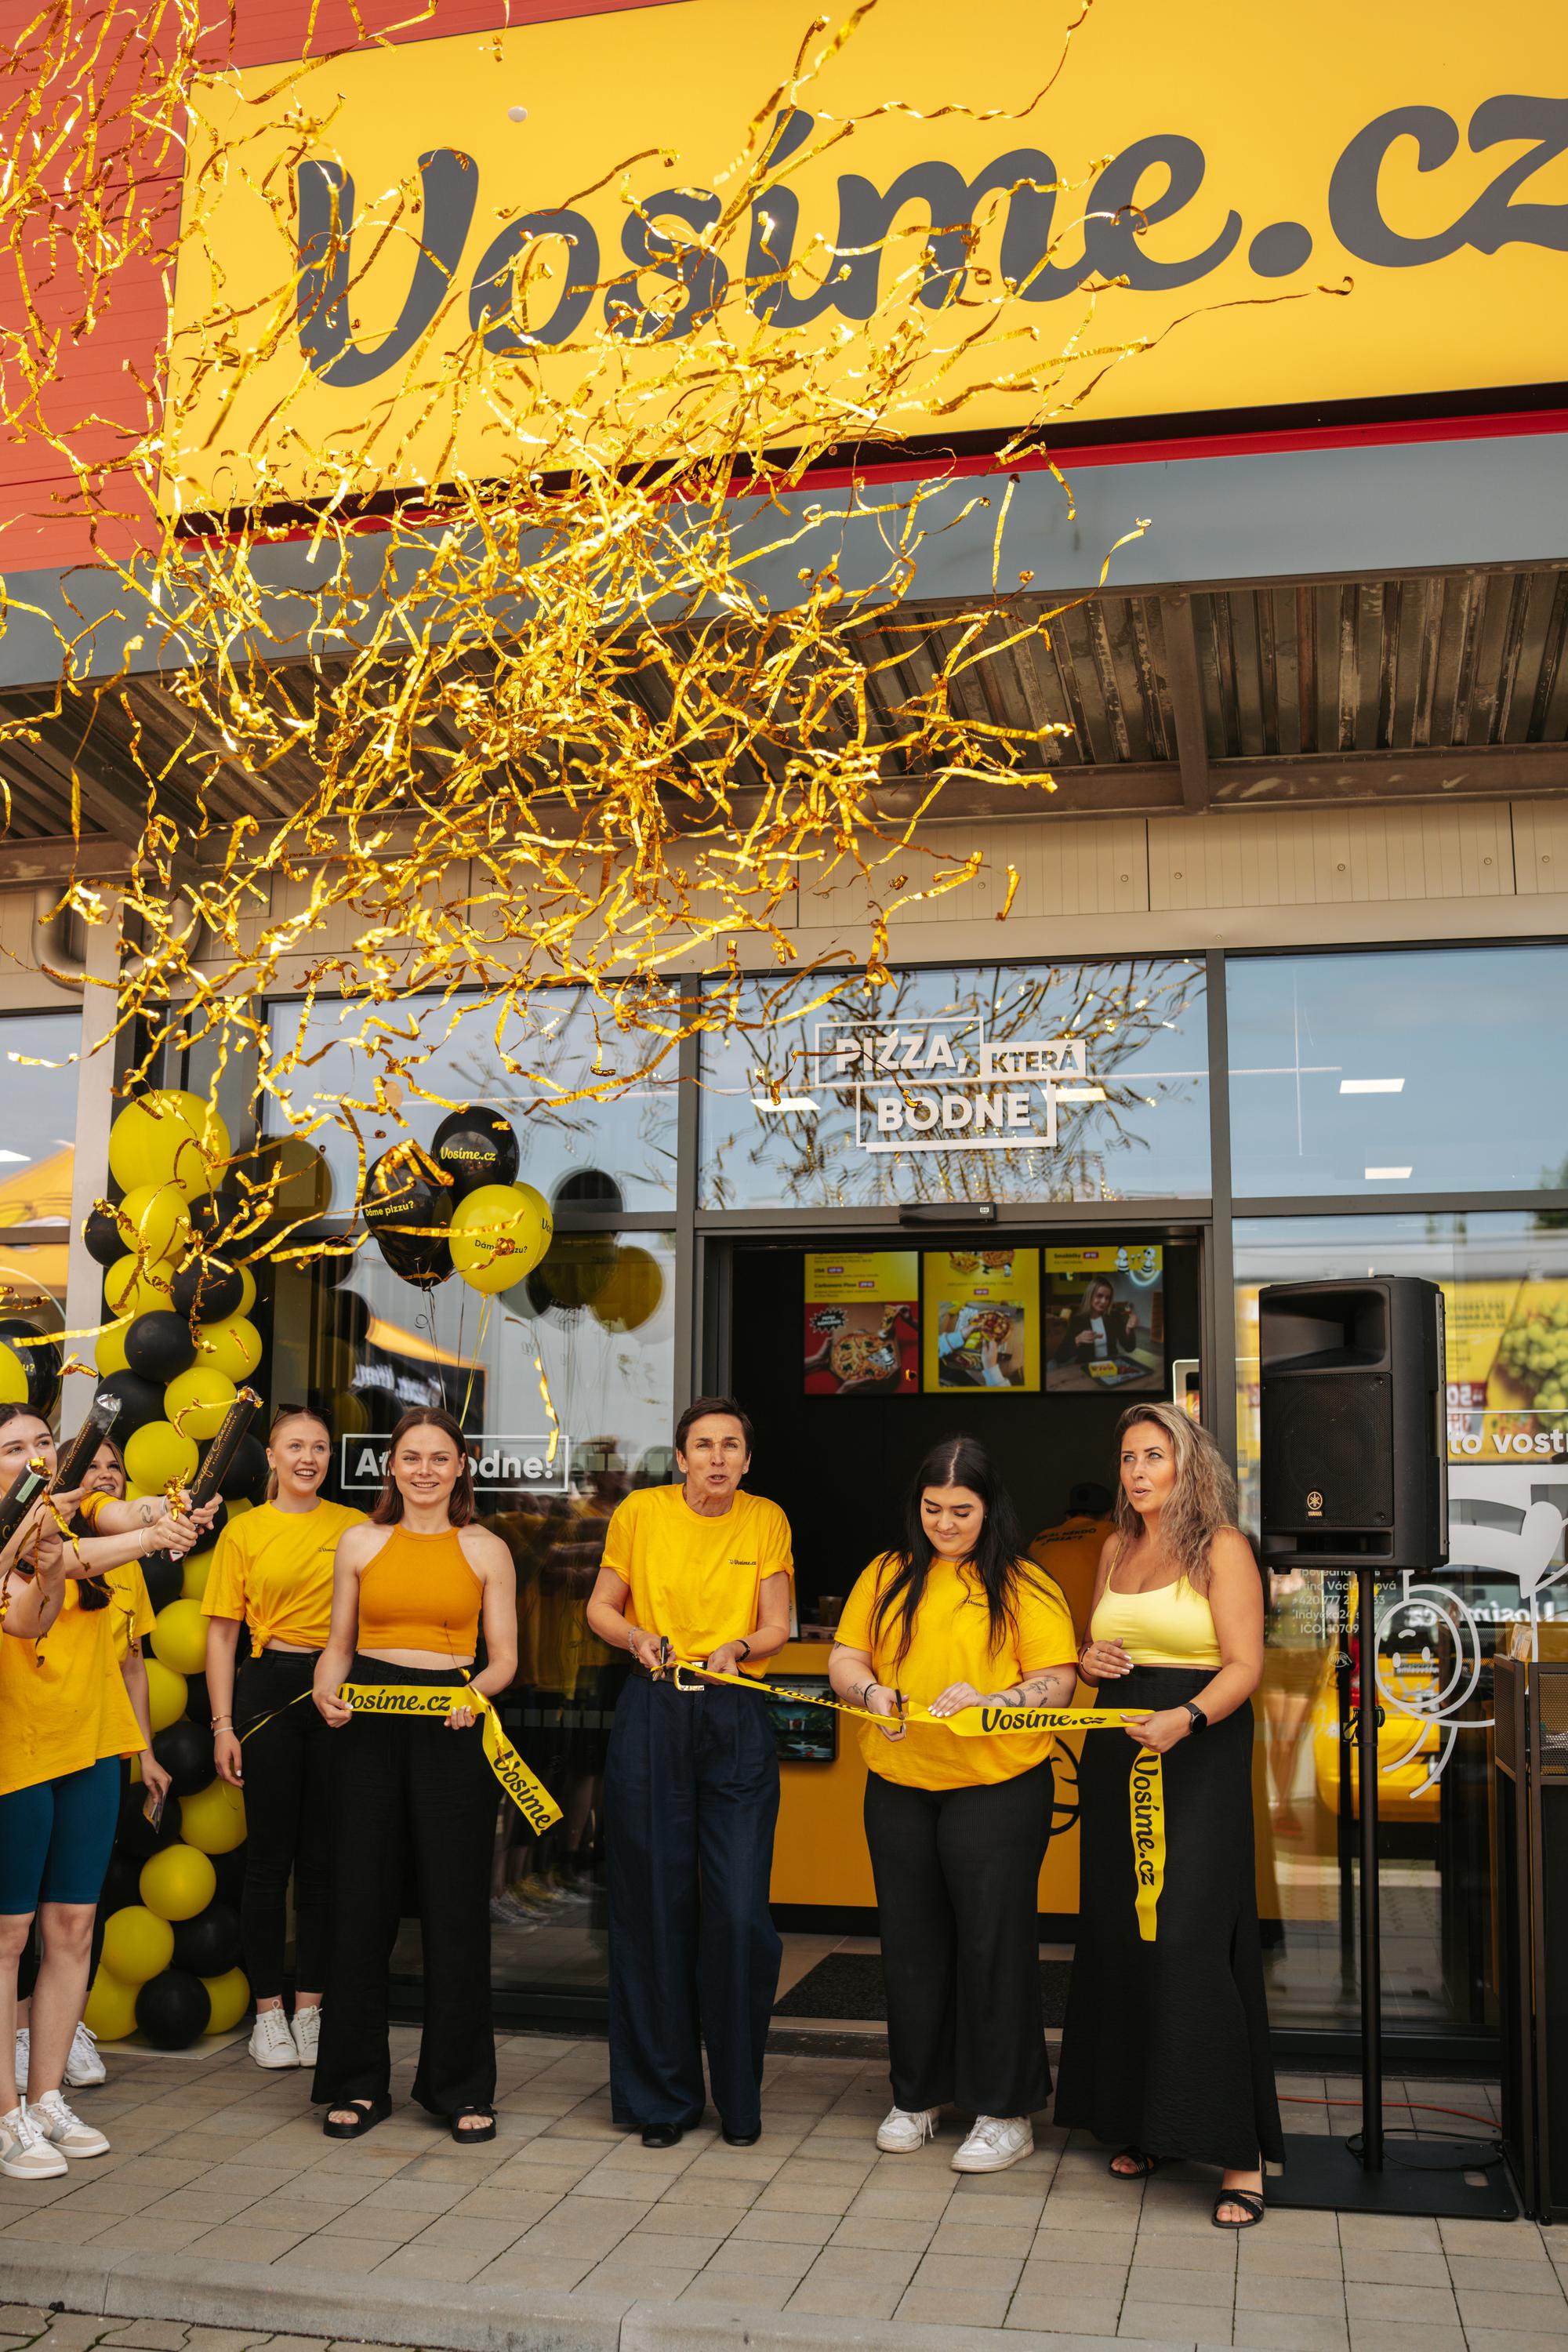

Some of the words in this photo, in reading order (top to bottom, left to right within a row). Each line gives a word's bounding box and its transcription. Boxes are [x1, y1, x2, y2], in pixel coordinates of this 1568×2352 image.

[298, 94, 1568, 387] Vosíme.cz
[836, 1034, 969, 1074] PIZZA,
[991, 1044, 1080, 1074] KTERÁ
[877, 1092, 1031, 1132] BODNE
[441, 1146, 496, 1161] Vosíme.cz
[474, 1239, 495, 1250] Dám
[1492, 1428, 1568, 1454] vost
[338, 1686, 452, 1711] Vosíme.cz
[982, 1708, 1107, 1733] Vosíme.cz
[1133, 1754, 1160, 1886] Vosíme.cz
